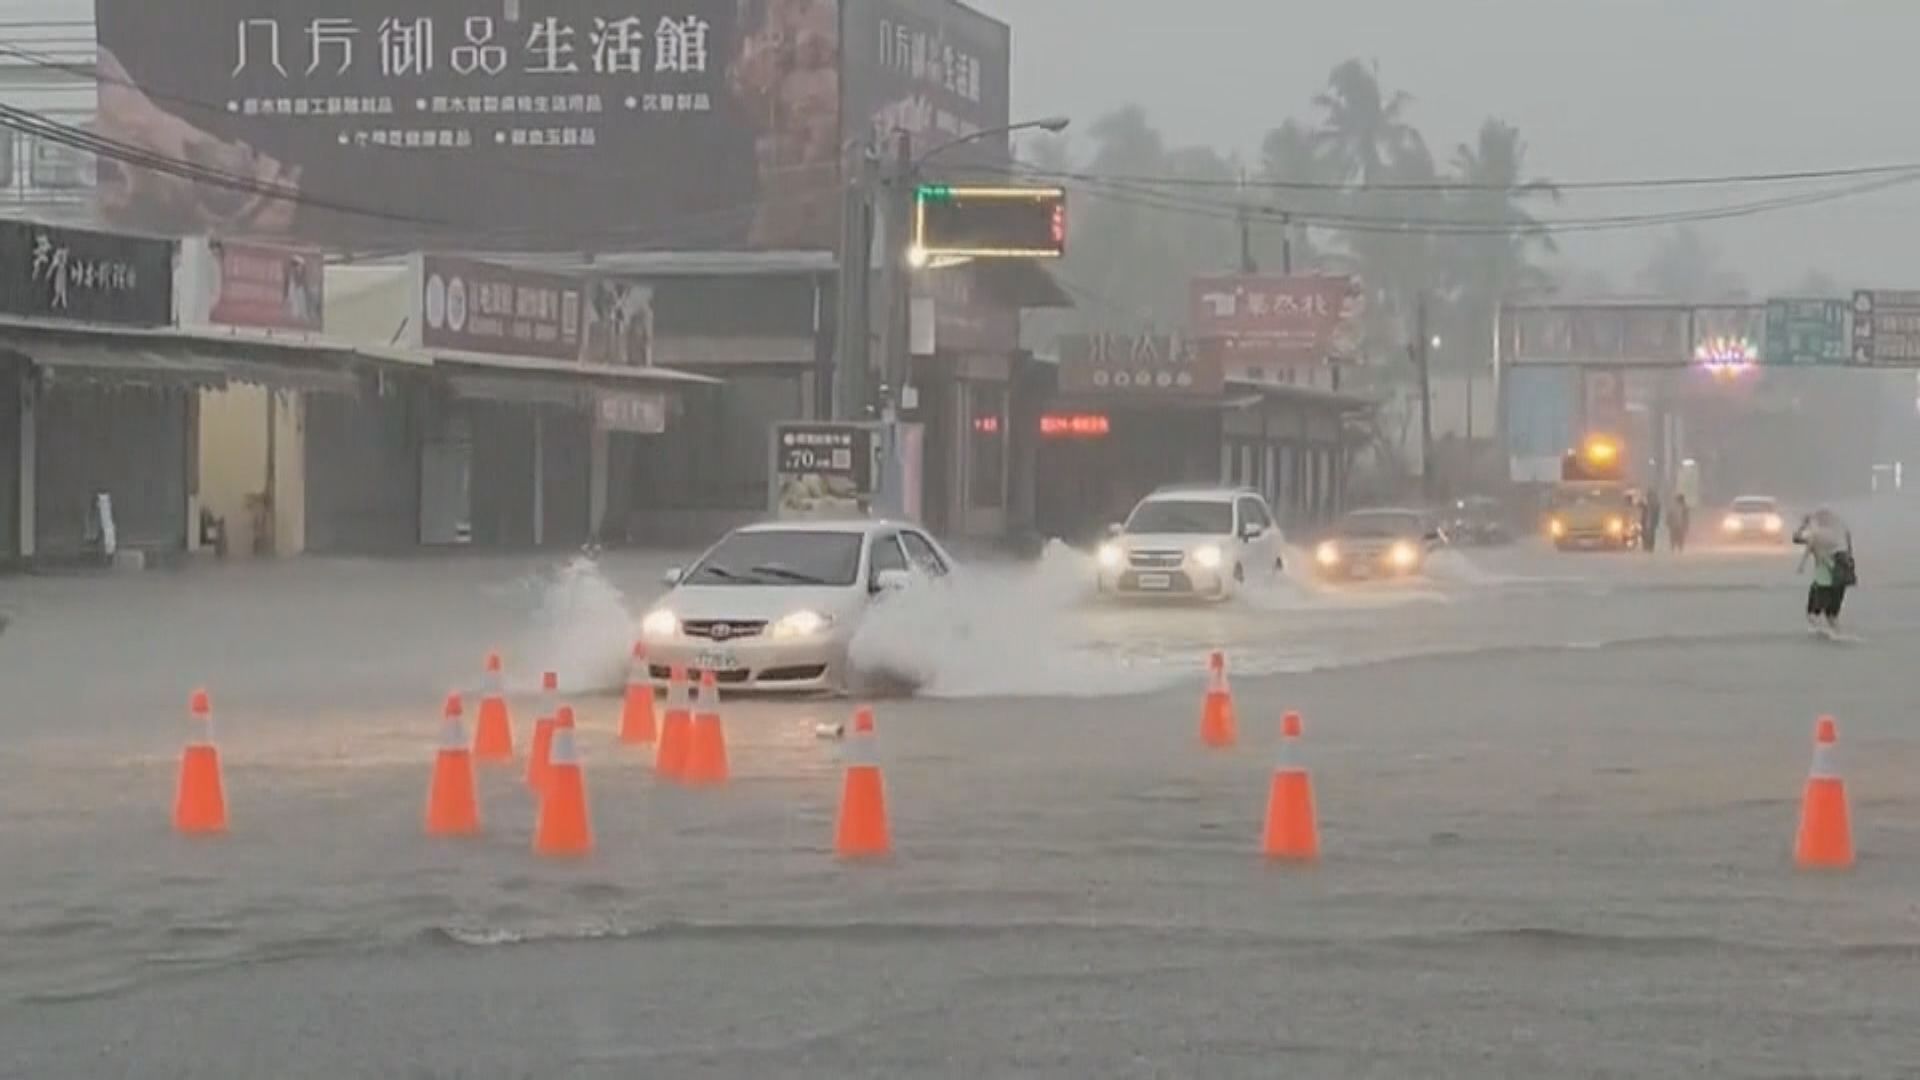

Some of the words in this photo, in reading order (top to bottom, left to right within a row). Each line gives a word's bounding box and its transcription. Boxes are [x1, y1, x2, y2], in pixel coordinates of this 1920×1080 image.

[232, 15, 710, 77] 八方御品生活館
